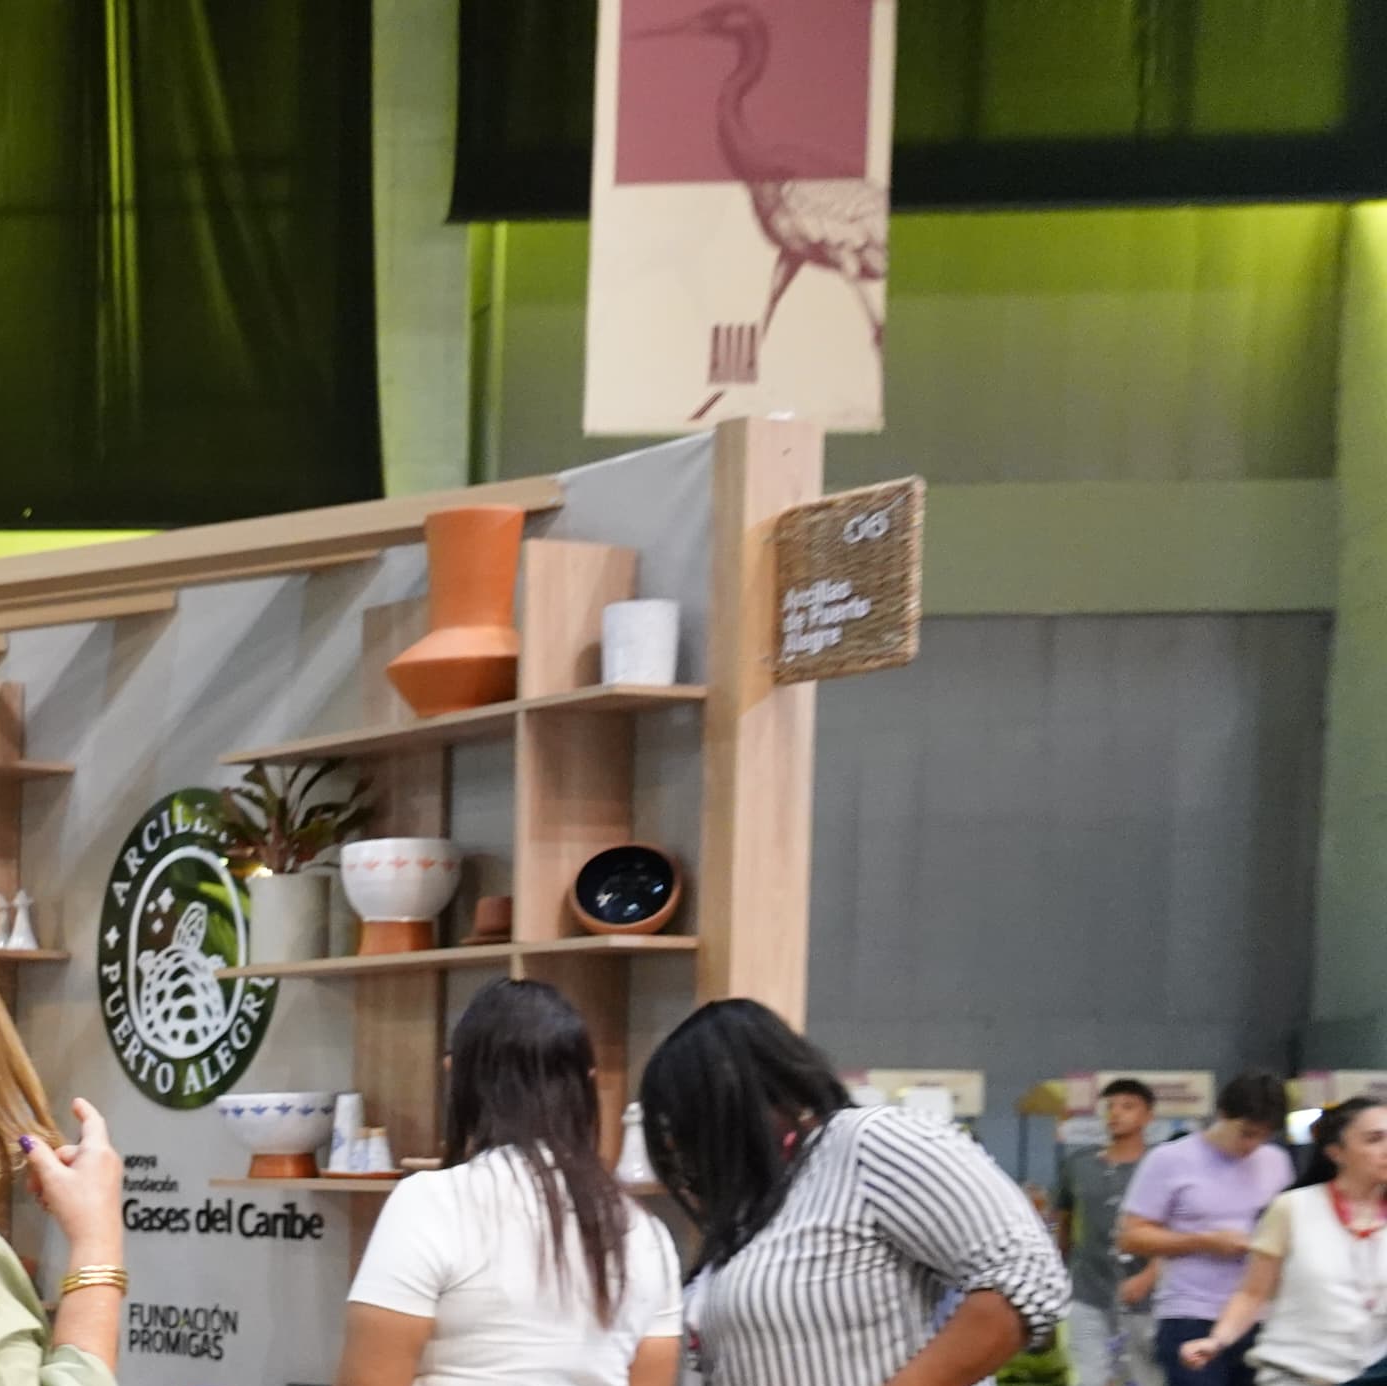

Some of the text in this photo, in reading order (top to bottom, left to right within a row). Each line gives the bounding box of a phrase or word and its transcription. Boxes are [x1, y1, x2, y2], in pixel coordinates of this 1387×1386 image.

[113, 804, 236, 907] ARCILL
[101, 959, 175, 1094] PUERTO
[122, 1198, 324, 1240] Gases del Caribe
[129, 1302, 239, 1335] FUNDACIÓN
[129, 1329, 225, 1361] PROMIGAS
